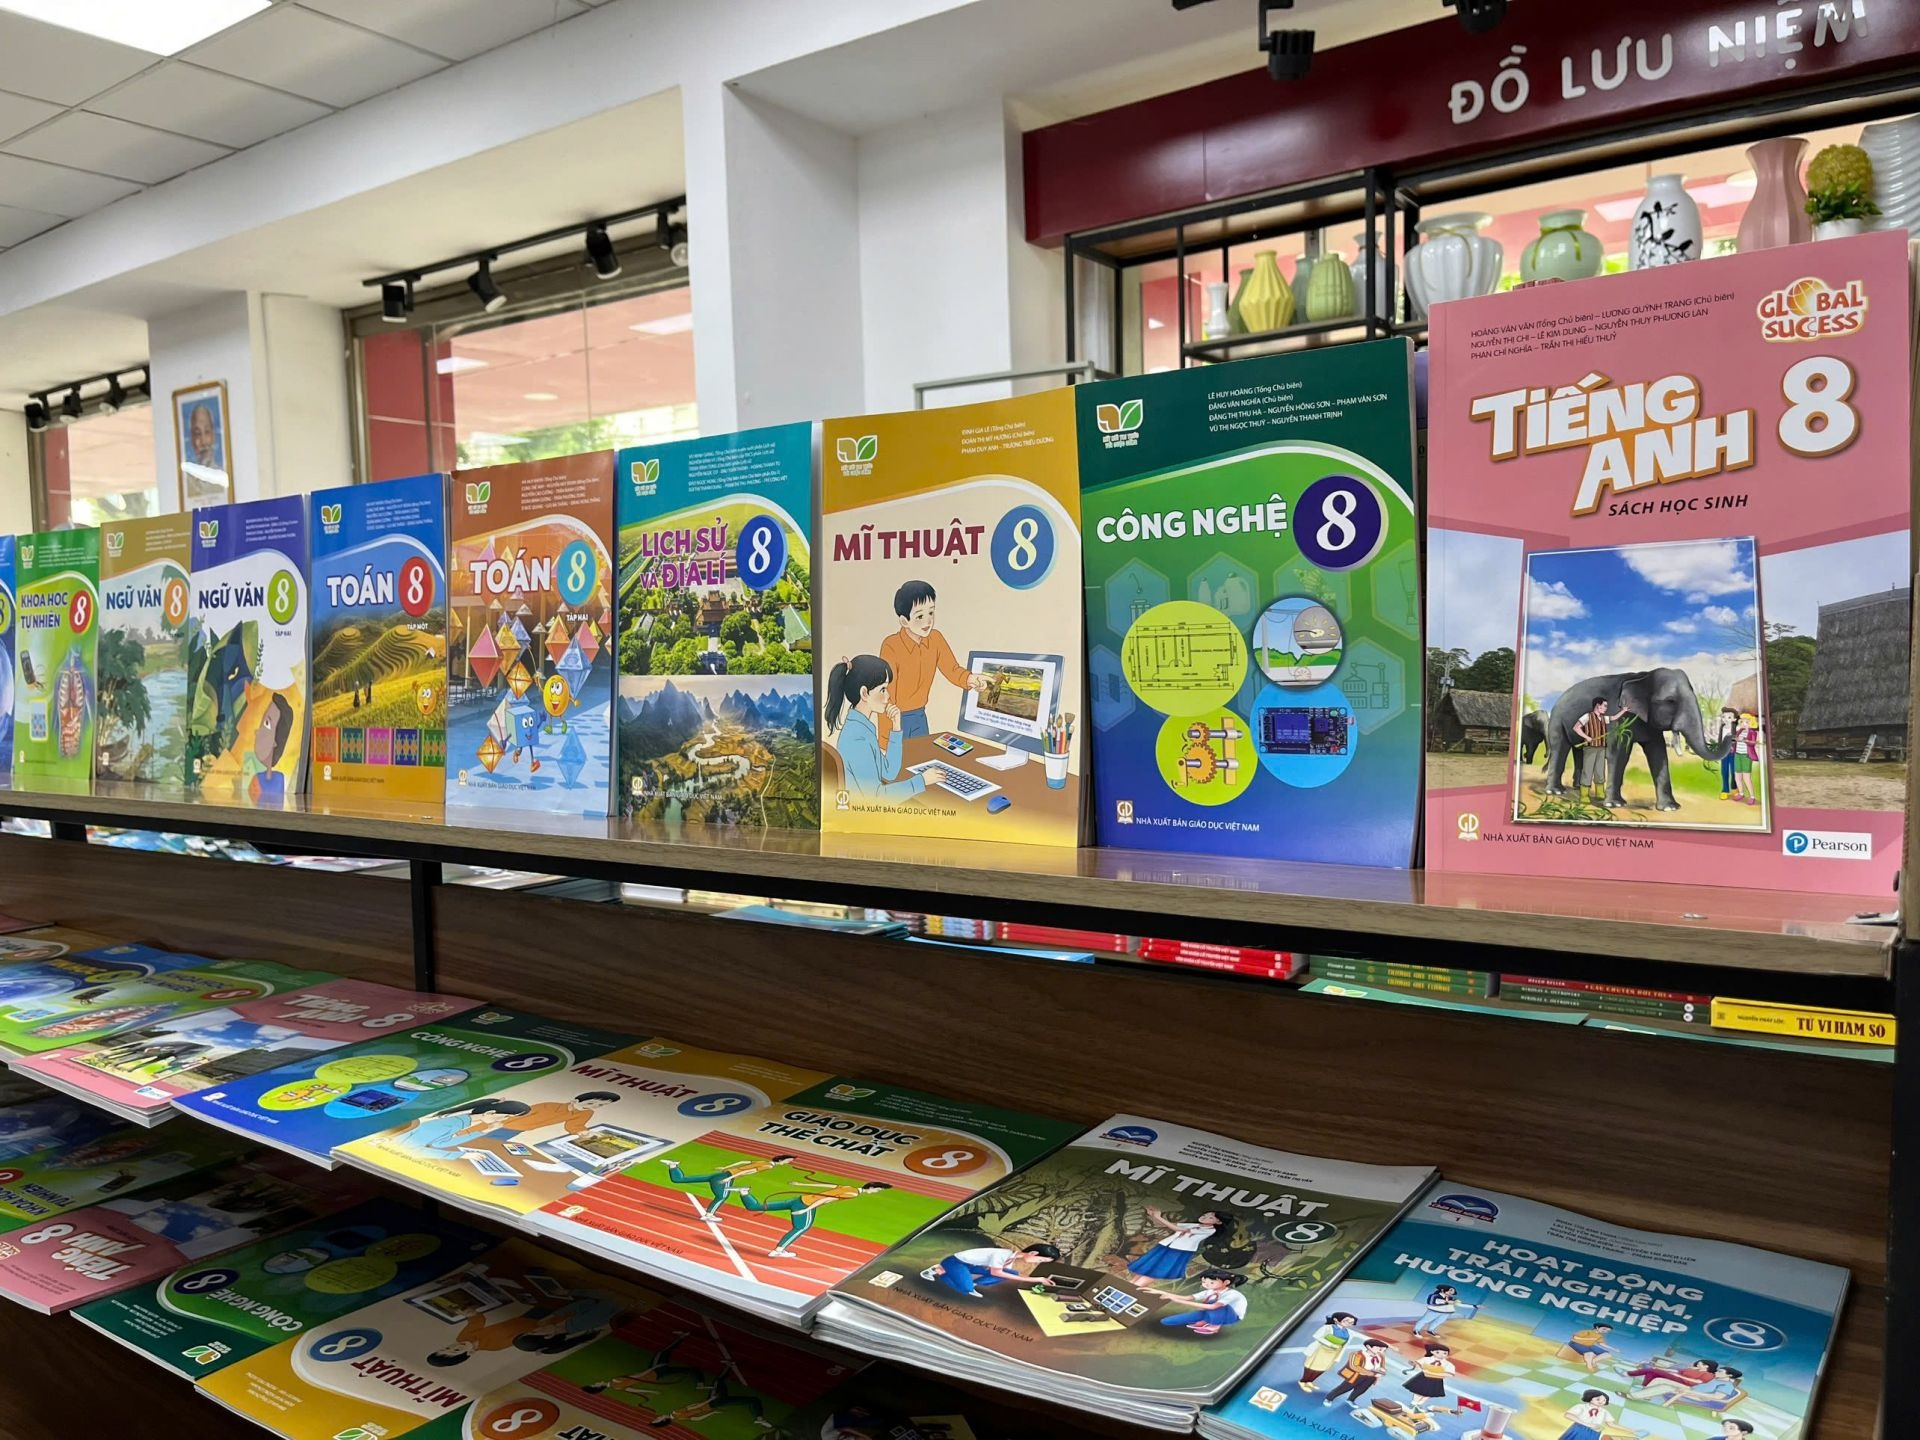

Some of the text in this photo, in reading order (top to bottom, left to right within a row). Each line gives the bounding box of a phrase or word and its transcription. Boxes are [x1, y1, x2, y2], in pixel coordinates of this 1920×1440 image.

[1448, 0, 1868, 124] ĐỒ LƯU NIỆM
[1546, 329, 1560, 338] KIM
[1562, 326, 1587, 336] DUNG
[1763, 311, 1860, 339] SUCCESS
[1216, 389, 1229, 399] HUY
[1778, 355, 1856, 453] 8
[1299, 411, 1322, 422] THANH
[1571, 410, 1751, 513] ANH
[1096, 490, 1357, 551] CÔNG NGHỆ 8
[1608, 494, 1749, 517] SÁCH HỌC SINH
[642, 517, 728, 562] LỊCH SỬ
[748, 526, 772, 574] 8
[833, 517, 1039, 571] MĨ THUẬT 8
[327, 566, 424, 606] TOÁN 8
[470, 549, 587, 593] TOÁN 8
[640, 552, 726, 594] VÀ ĐỊA LÍ
[21, 592, 68, 608] KHOA HỌC
[74, 596, 88, 626] 8
[106, 584, 183, 617] NGỮ VĂN 8
[199, 578, 290, 613] NGỮ VĂN 8
[32, 610, 61, 628] NHIÊN
[1136, 816, 1152, 825] NHÀ
[1153, 816, 1171, 827] XUẤT
[1189, 818, 1207, 829] GIÁO
[1224, 820, 1241, 831] VIỆT
[1242, 823, 1260, 832] NAM
[1483, 832, 1503, 842] NHÀ
[1506, 833, 1531, 843] XUẤT
[1533, 834, 1553, 844] BẢN
[1555, 835, 1580, 846] GIÁO
[1605, 838, 1627, 848] VIỆT
[1629, 839, 1654, 849] NAM
[1812, 837, 1868, 854] Pearson
[276, 1009, 367, 1023] ANH
[362, 1013, 416, 1027] 8
[1818, 1018, 1831, 1033] VI
[411, 1031, 551, 1071] CÔNG NGHỆ 8
[570, 1063, 742, 1114] MĨ THUẬT 8
[759, 1119, 896, 1158] THỂ CHẤT
[784, 1110, 857, 1133] GIÁO
[856, 1123, 922, 1150] DỤC
[922, 1150, 975, 1170] 8
[1104, 1158, 1176, 1184] MĨ
[1165, 1174, 1332, 1219] THUẬT
[1283, 1222, 1328, 1245] 8
[21, 1224, 74, 1243] 8
[61, 1232, 146, 1257] ANH
[1447, 1247, 1694, 1320] TRẢI NGHIỆM,
[1482, 1239, 1594, 1277] HOẠT
[1588, 1258, 1705, 1301] ĐỘNG
[183, 1273, 304, 1332] CÔNG NGHỆ 8
[1394, 1252, 1690, 1336] HƯỚNG NGHIỆP
[1012, 1331, 1034, 1343] NAM
[1722, 1322, 1769, 1346] 8
[320, 1335, 468, 1409] MĨ THUẬT 8
[492, 1409, 543, 1432] 8
[1283, 1411, 1307, 1425] NHÀ
